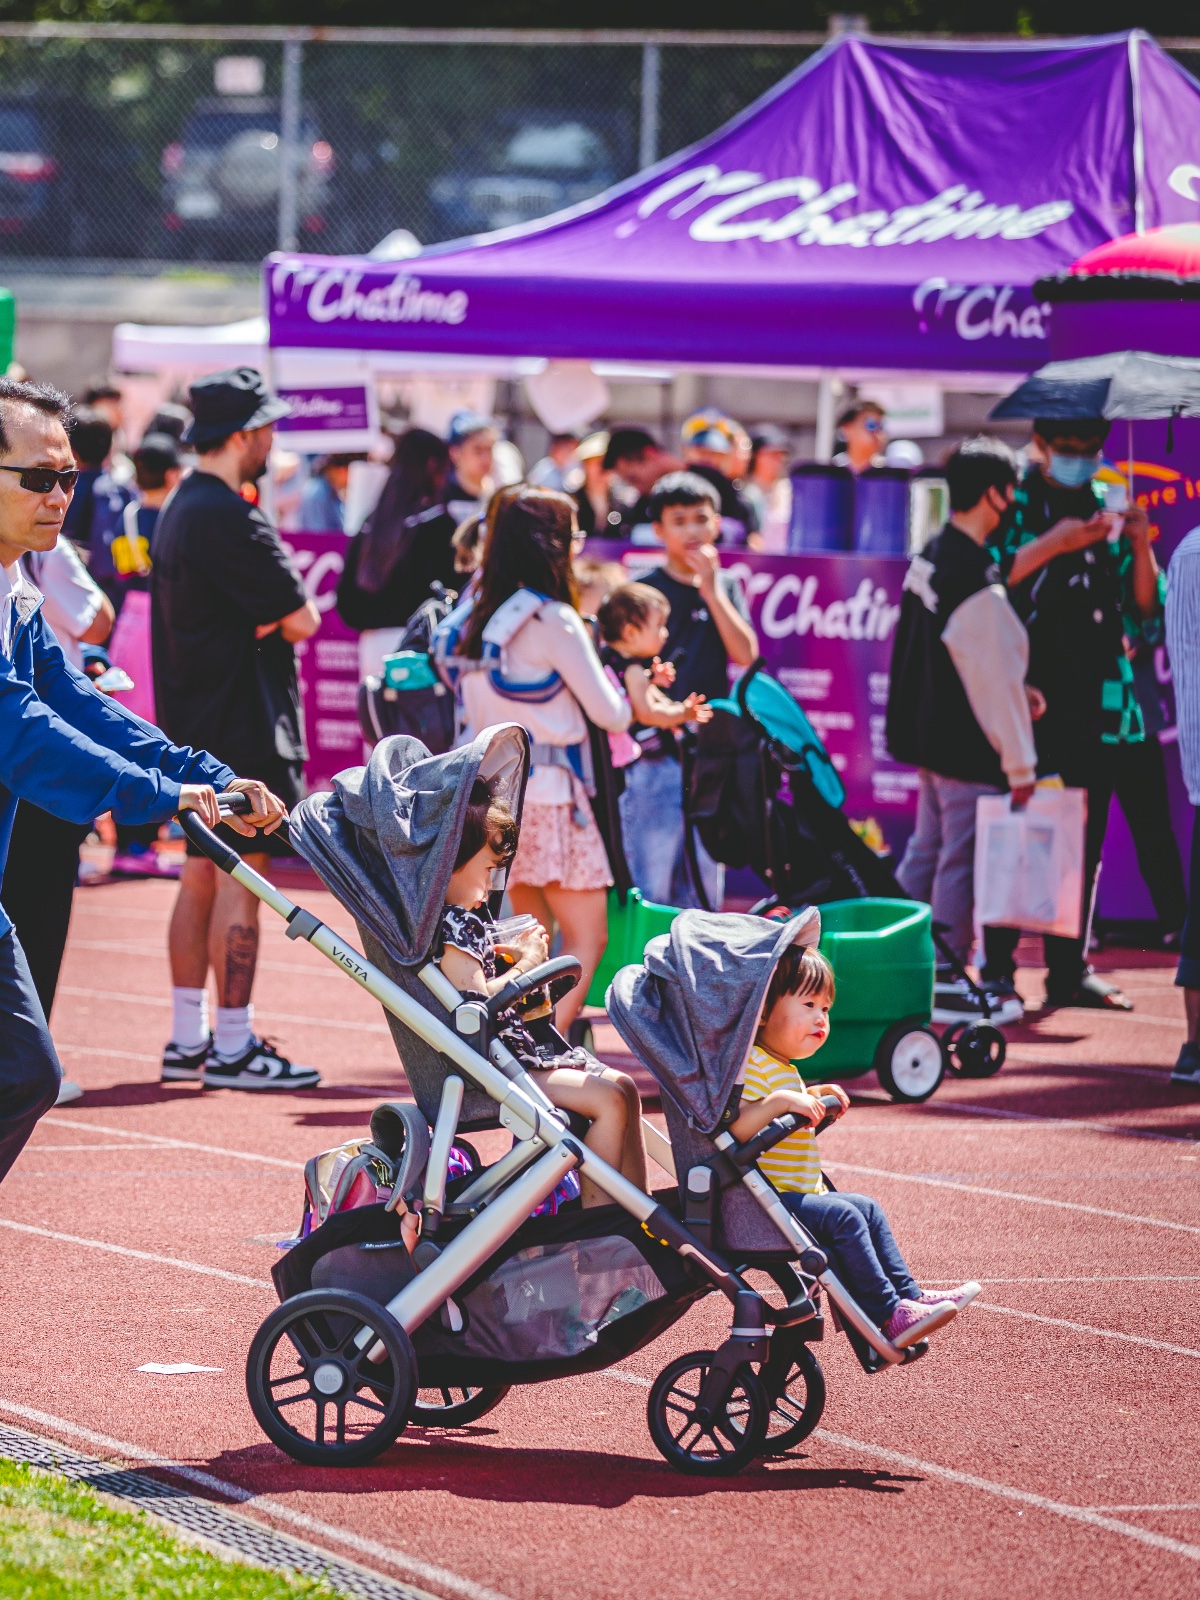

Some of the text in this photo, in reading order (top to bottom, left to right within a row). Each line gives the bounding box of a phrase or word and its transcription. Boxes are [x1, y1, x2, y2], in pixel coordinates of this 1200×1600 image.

[689, 176, 1074, 247] Chatime
[307, 269, 469, 324] Chatime
[332, 946, 368, 982] VISTA
